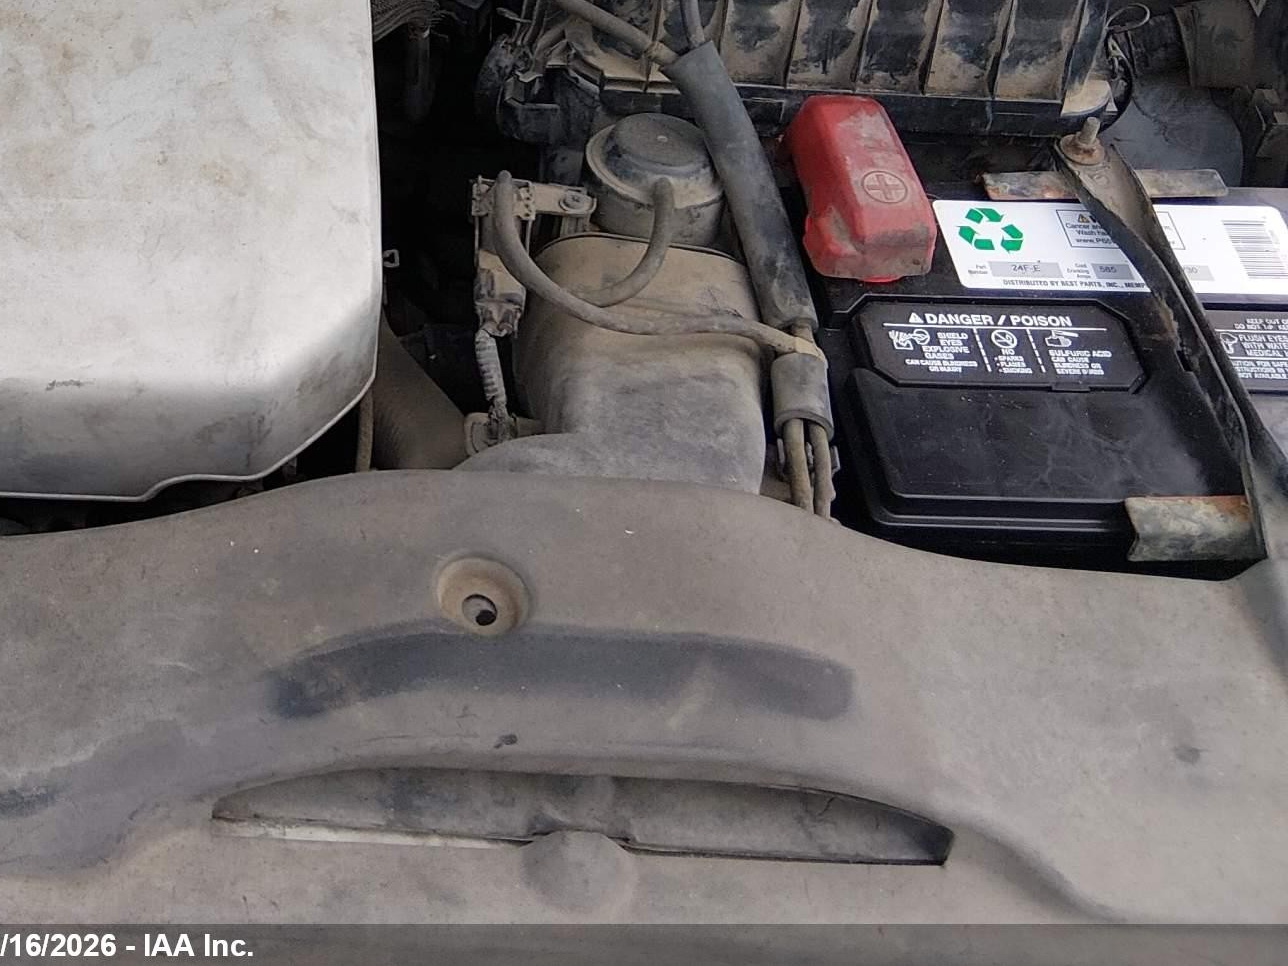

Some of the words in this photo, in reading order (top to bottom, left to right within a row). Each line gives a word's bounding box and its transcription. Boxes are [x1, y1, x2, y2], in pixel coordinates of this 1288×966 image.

[1011, 264, 1041, 273] 24F-E
[1002, 279, 1048, 287] DISTRIBUTED
[924, 313, 994, 325] DANGER
[997, 314, 1007, 326] /
[1010, 315, 1072, 327] POISON
[1238, 334, 1266, 342] FLUSH
[921, 345, 970, 353] EXPLOSIVE
[1048, 349, 1091, 357] SULFURIC
